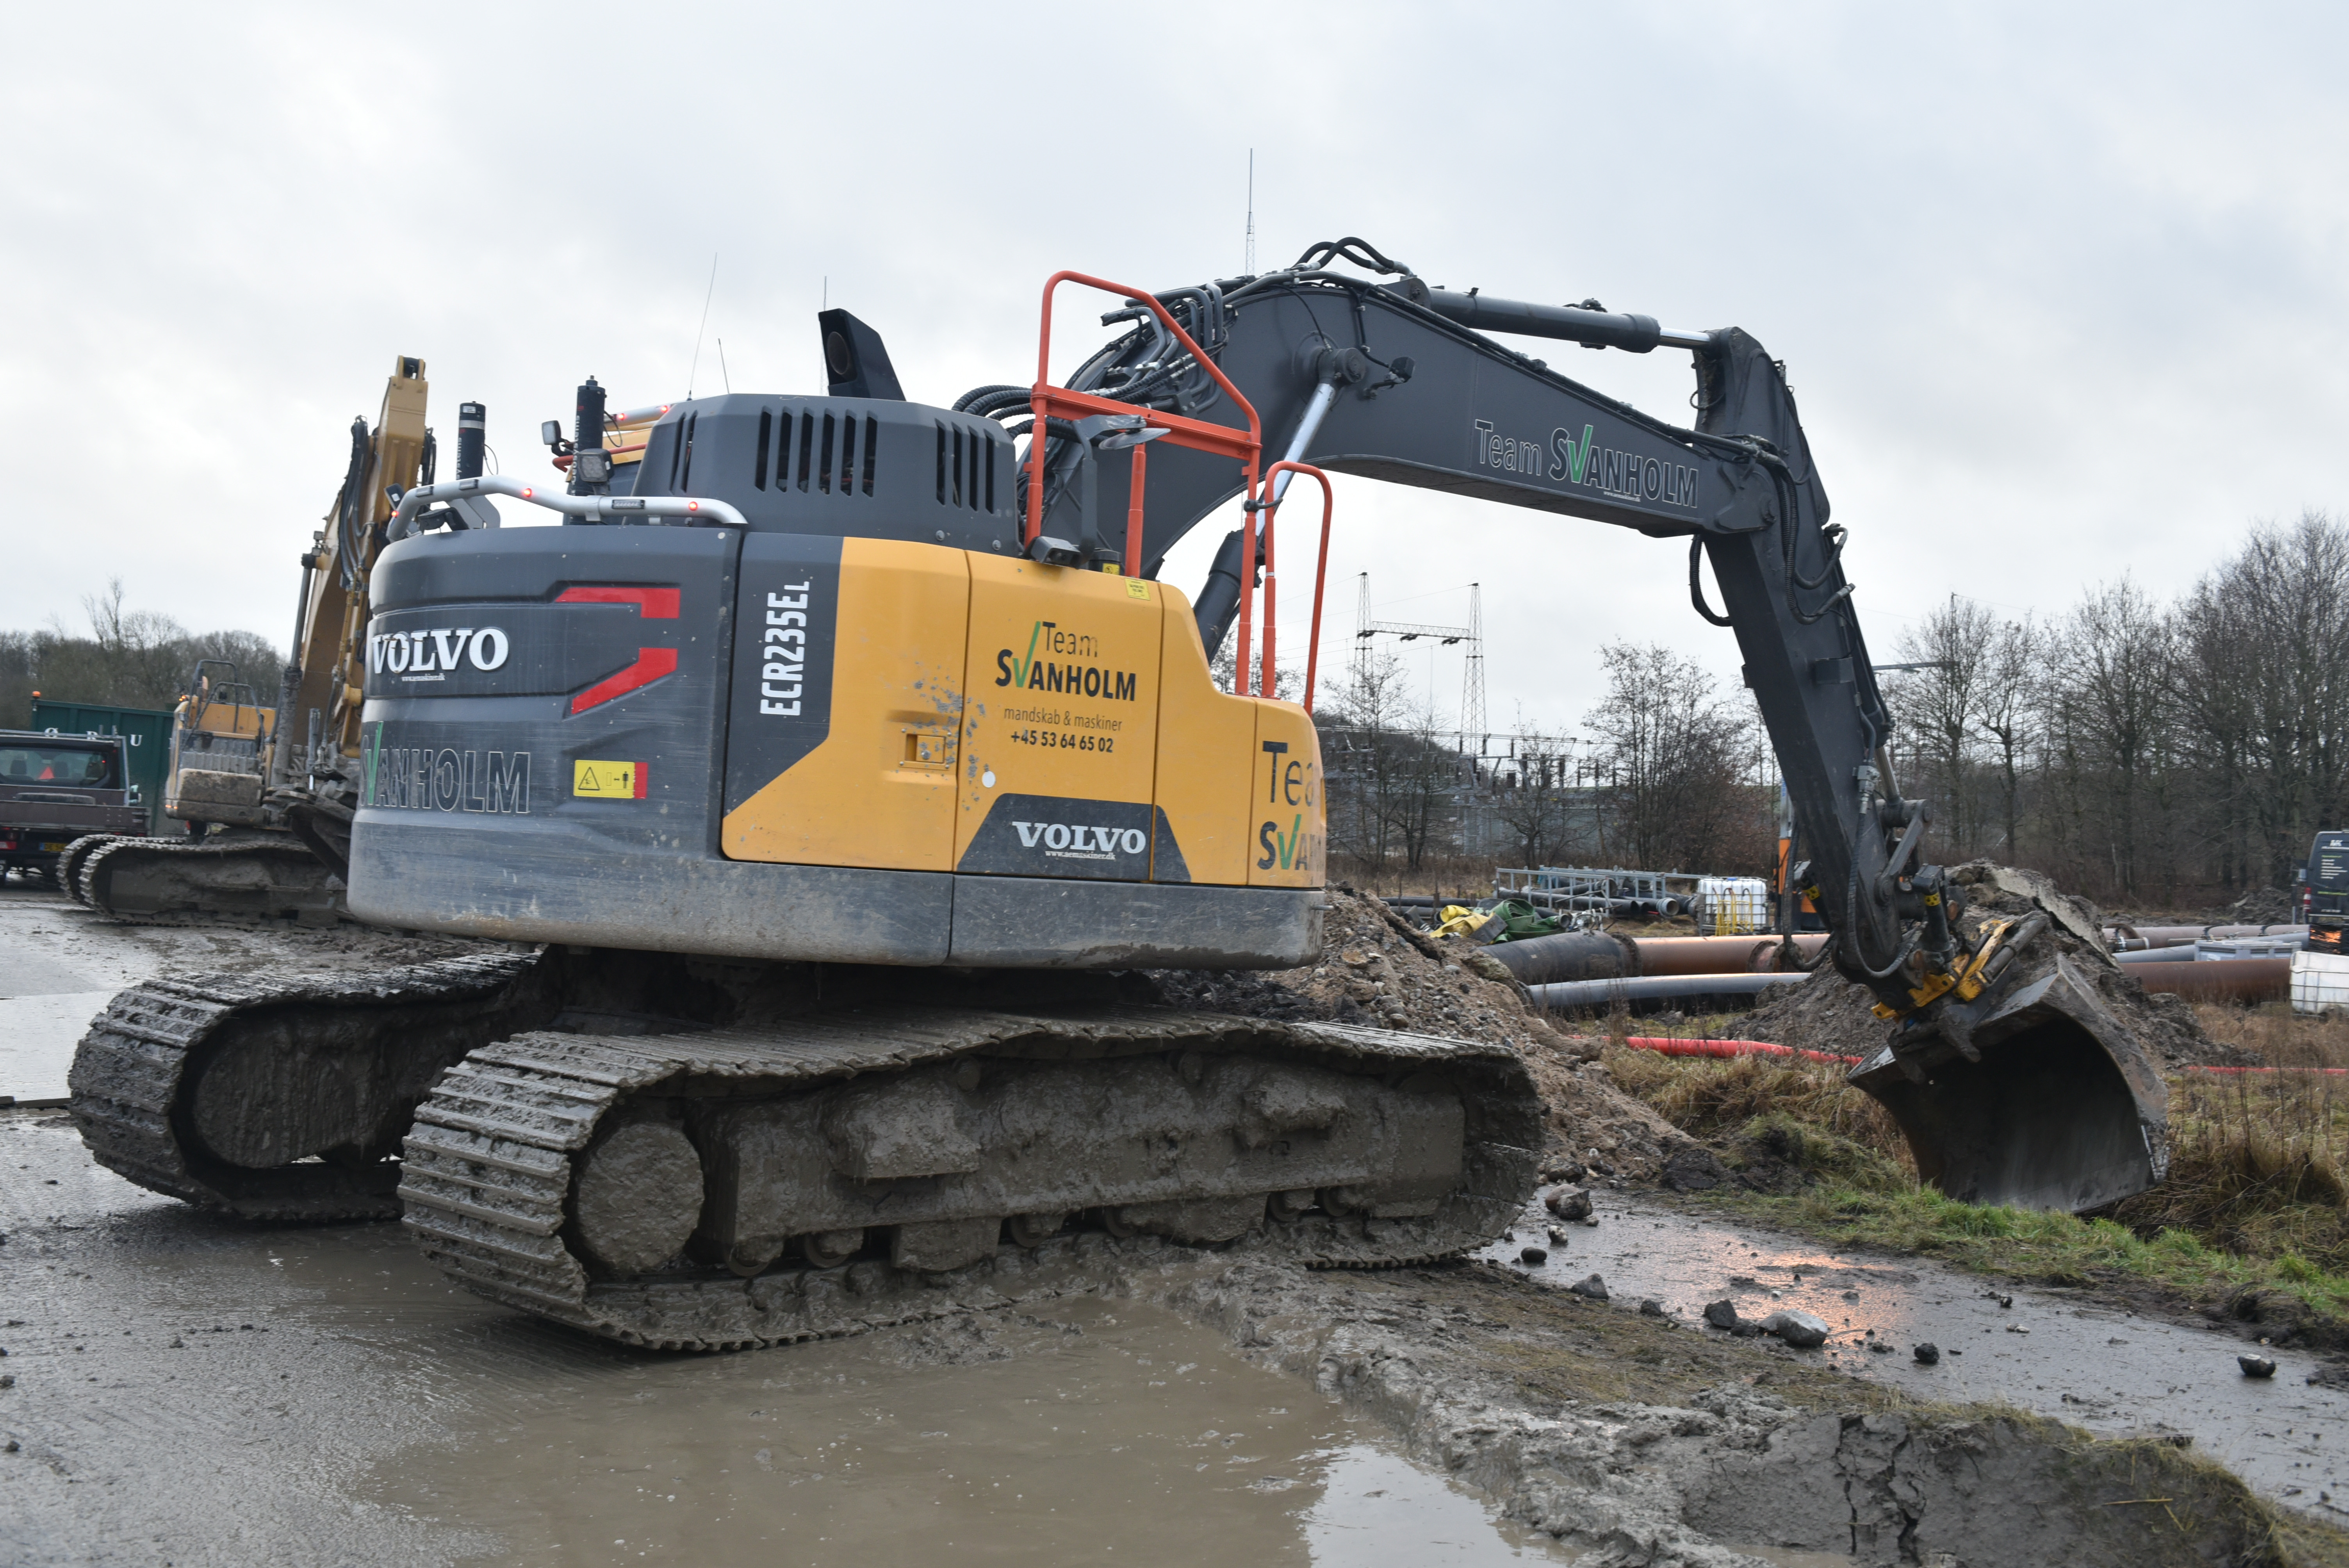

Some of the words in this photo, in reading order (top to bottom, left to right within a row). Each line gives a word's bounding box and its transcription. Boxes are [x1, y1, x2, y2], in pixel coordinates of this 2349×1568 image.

[1474, 419, 1542, 476] Team
[1548, 424, 1698, 508] SVANHOLM
[371, 627, 509, 674] VOLVO
[1042, 621, 1098, 658] Team
[995, 621, 1136, 701] SVANHOLM
[1004, 707, 1060, 725] mandskab
[1063, 711, 1071, 726] &
[1074, 714, 1123, 731] maskiner
[1011, 729, 1037, 745] +45
[1041, 731, 1057, 747] 53
[1060, 733, 1076, 749] 64
[1079, 735, 1095, 751] 65
[1098, 737, 1114, 753] 02
[360, 721, 531, 813] SVANHOLM
[1012, 821, 1146, 854] VOLVO
